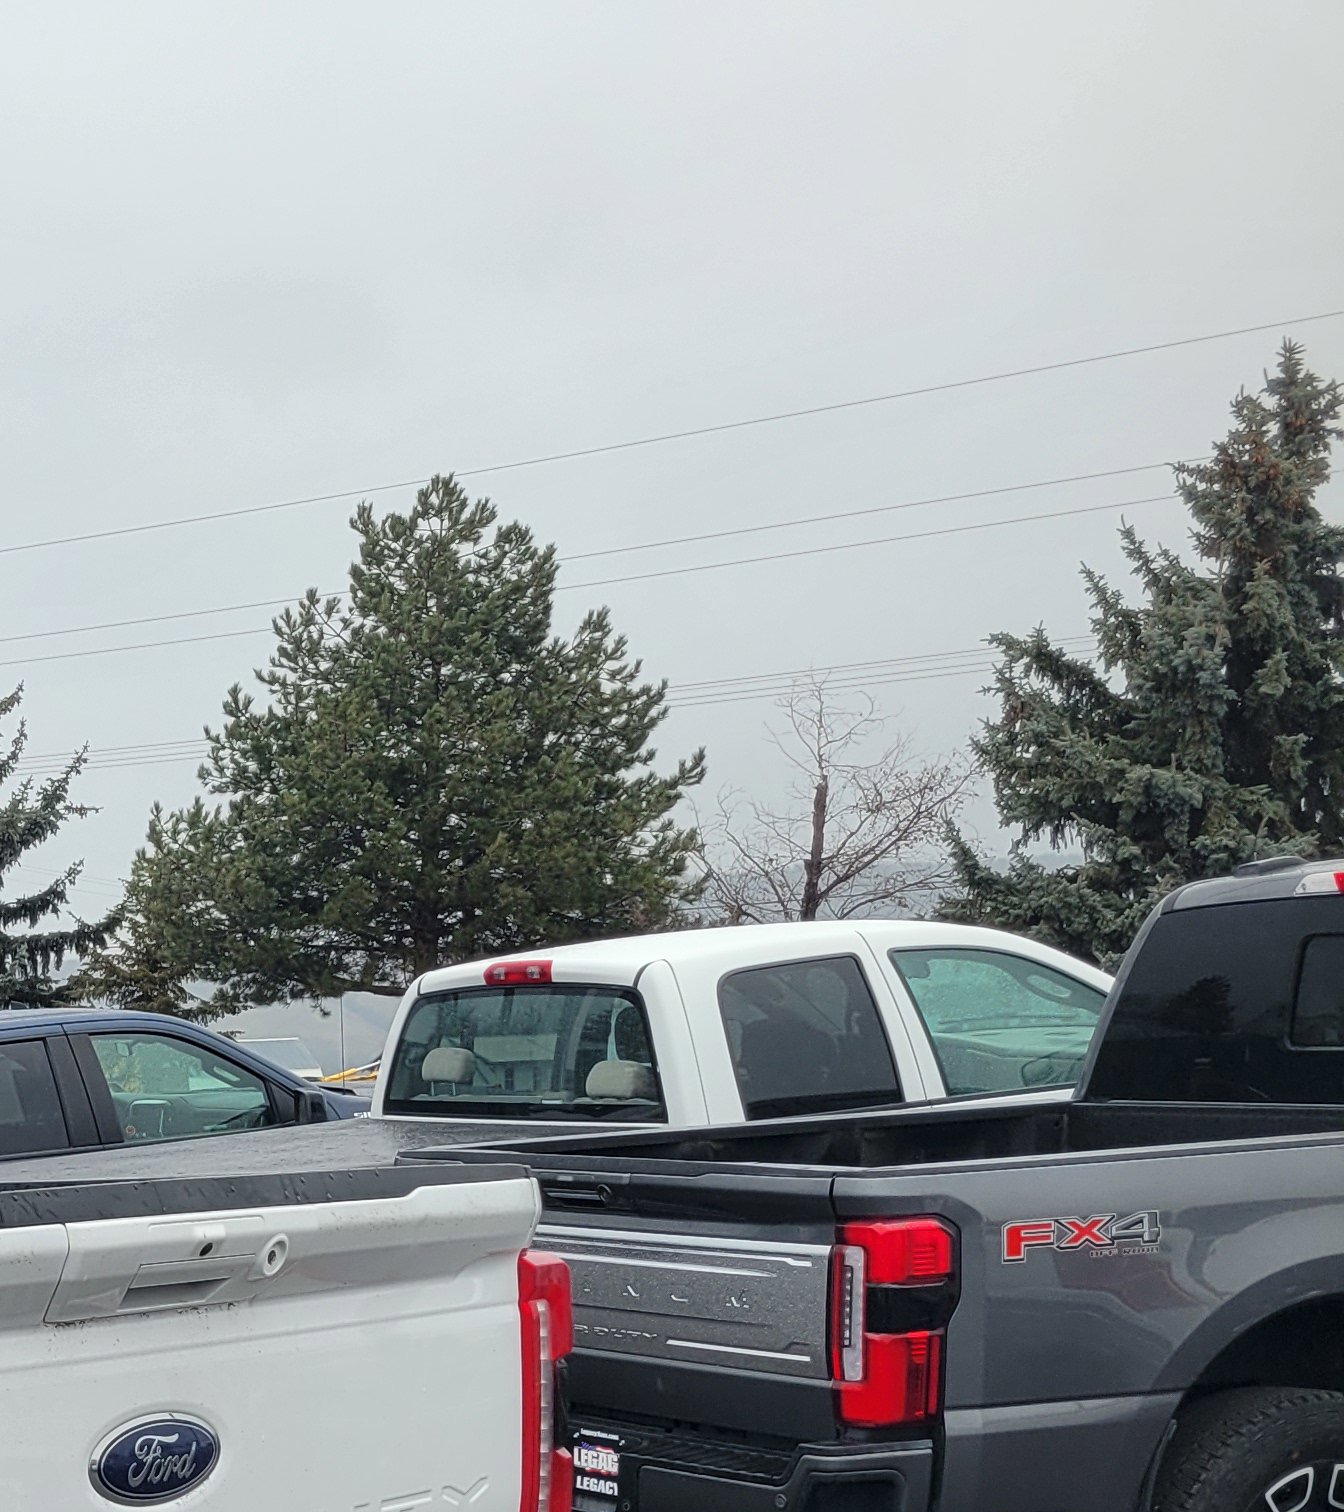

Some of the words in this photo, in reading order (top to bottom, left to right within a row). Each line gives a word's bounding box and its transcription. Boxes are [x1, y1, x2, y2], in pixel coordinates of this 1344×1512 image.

[1002, 1210, 1161, 1264] FX4
[128, 1433, 196, 1487] Ford
[573, 1446, 620, 1473] LEGAC
